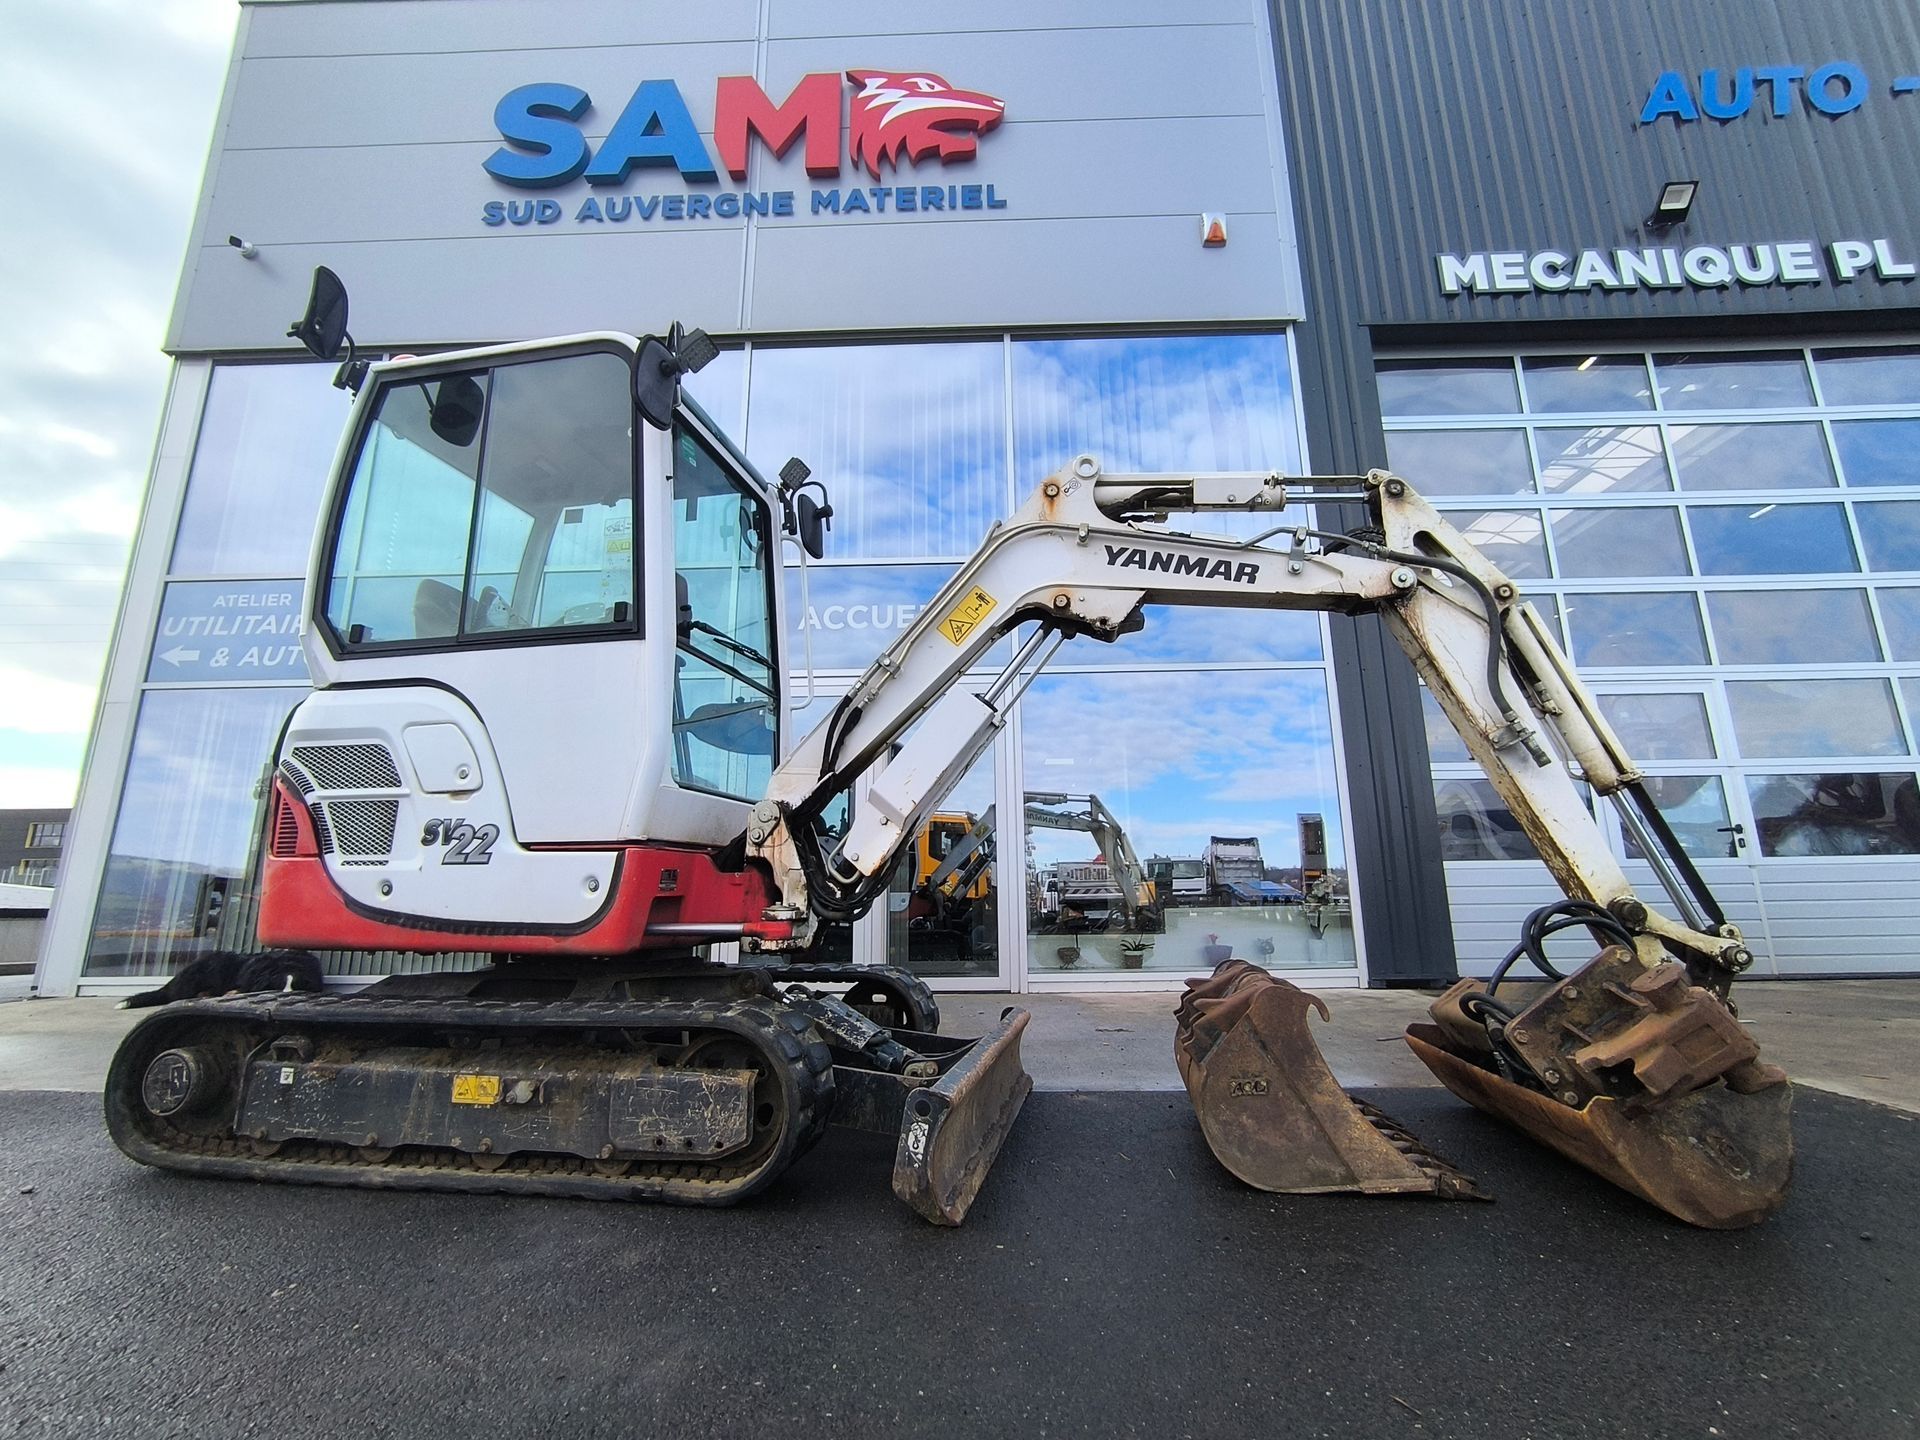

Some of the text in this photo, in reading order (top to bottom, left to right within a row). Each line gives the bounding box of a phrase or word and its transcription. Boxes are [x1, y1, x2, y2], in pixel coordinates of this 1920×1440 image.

[1639, 61, 1869, 123] AUTO
[481, 73, 842, 186] SAM
[482, 184, 1008, 226] SUD AUVERGNE MATERIEL
[1437, 239, 1916, 294] MECANIQUE PL
[1104, 545, 1260, 584] YANMAR
[213, 593, 292, 608] ATELIER
[797, 604, 927, 630] ACCUE
[209, 645, 309, 667] & AUT
